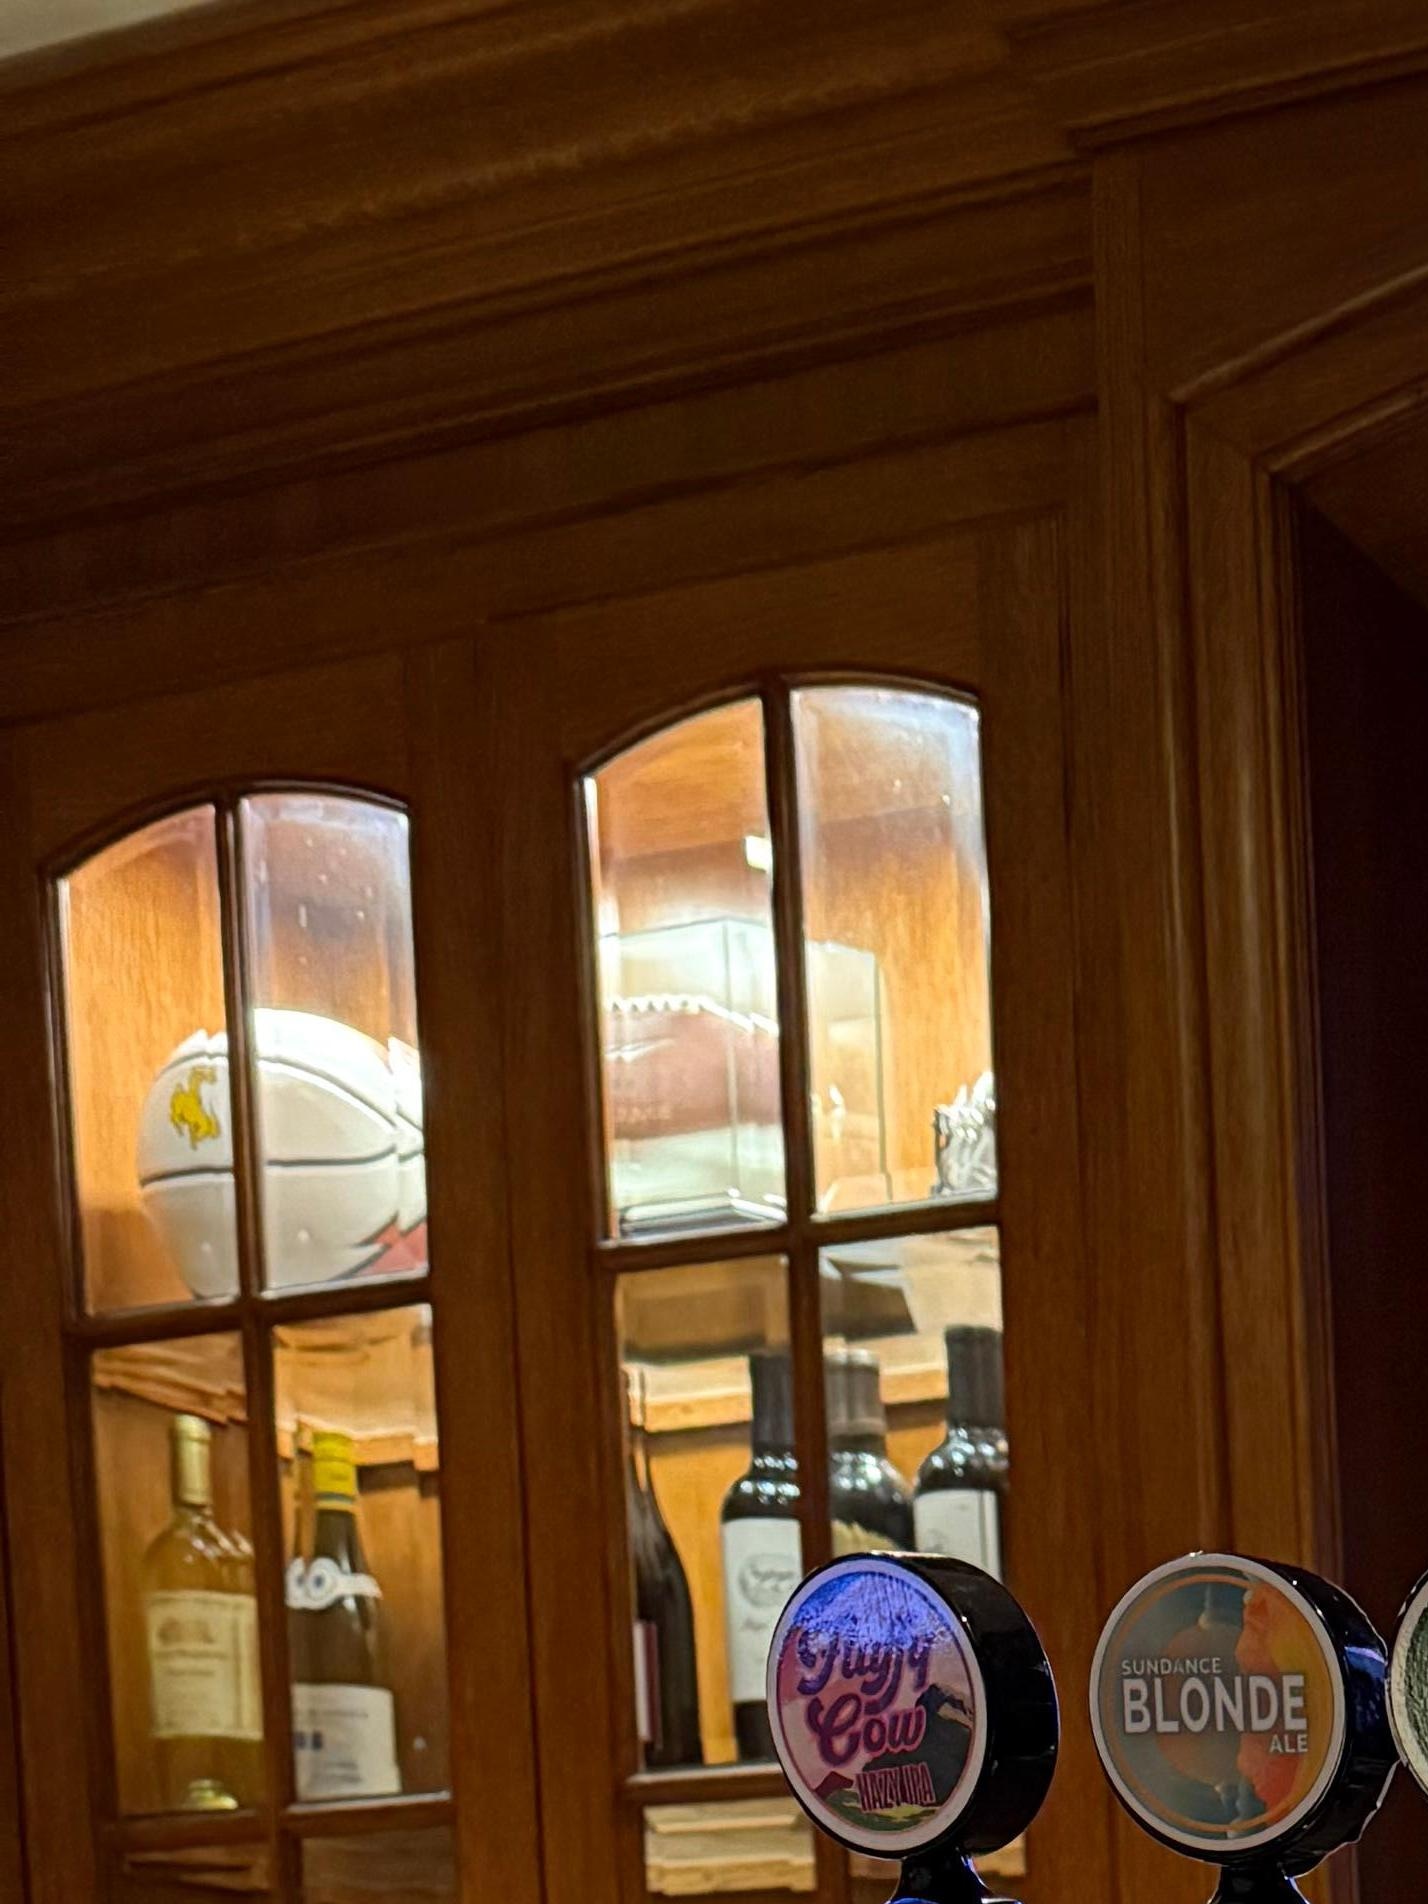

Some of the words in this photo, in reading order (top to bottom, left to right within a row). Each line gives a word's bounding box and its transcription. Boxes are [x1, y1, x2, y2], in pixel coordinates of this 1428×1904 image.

[1121, 1657, 1222, 1675] SUNDANCE
[1122, 1675, 1308, 1733] BLONDE
[806, 1692, 927, 1767] Cow
[1269, 1734, 1309, 1753] ALE
